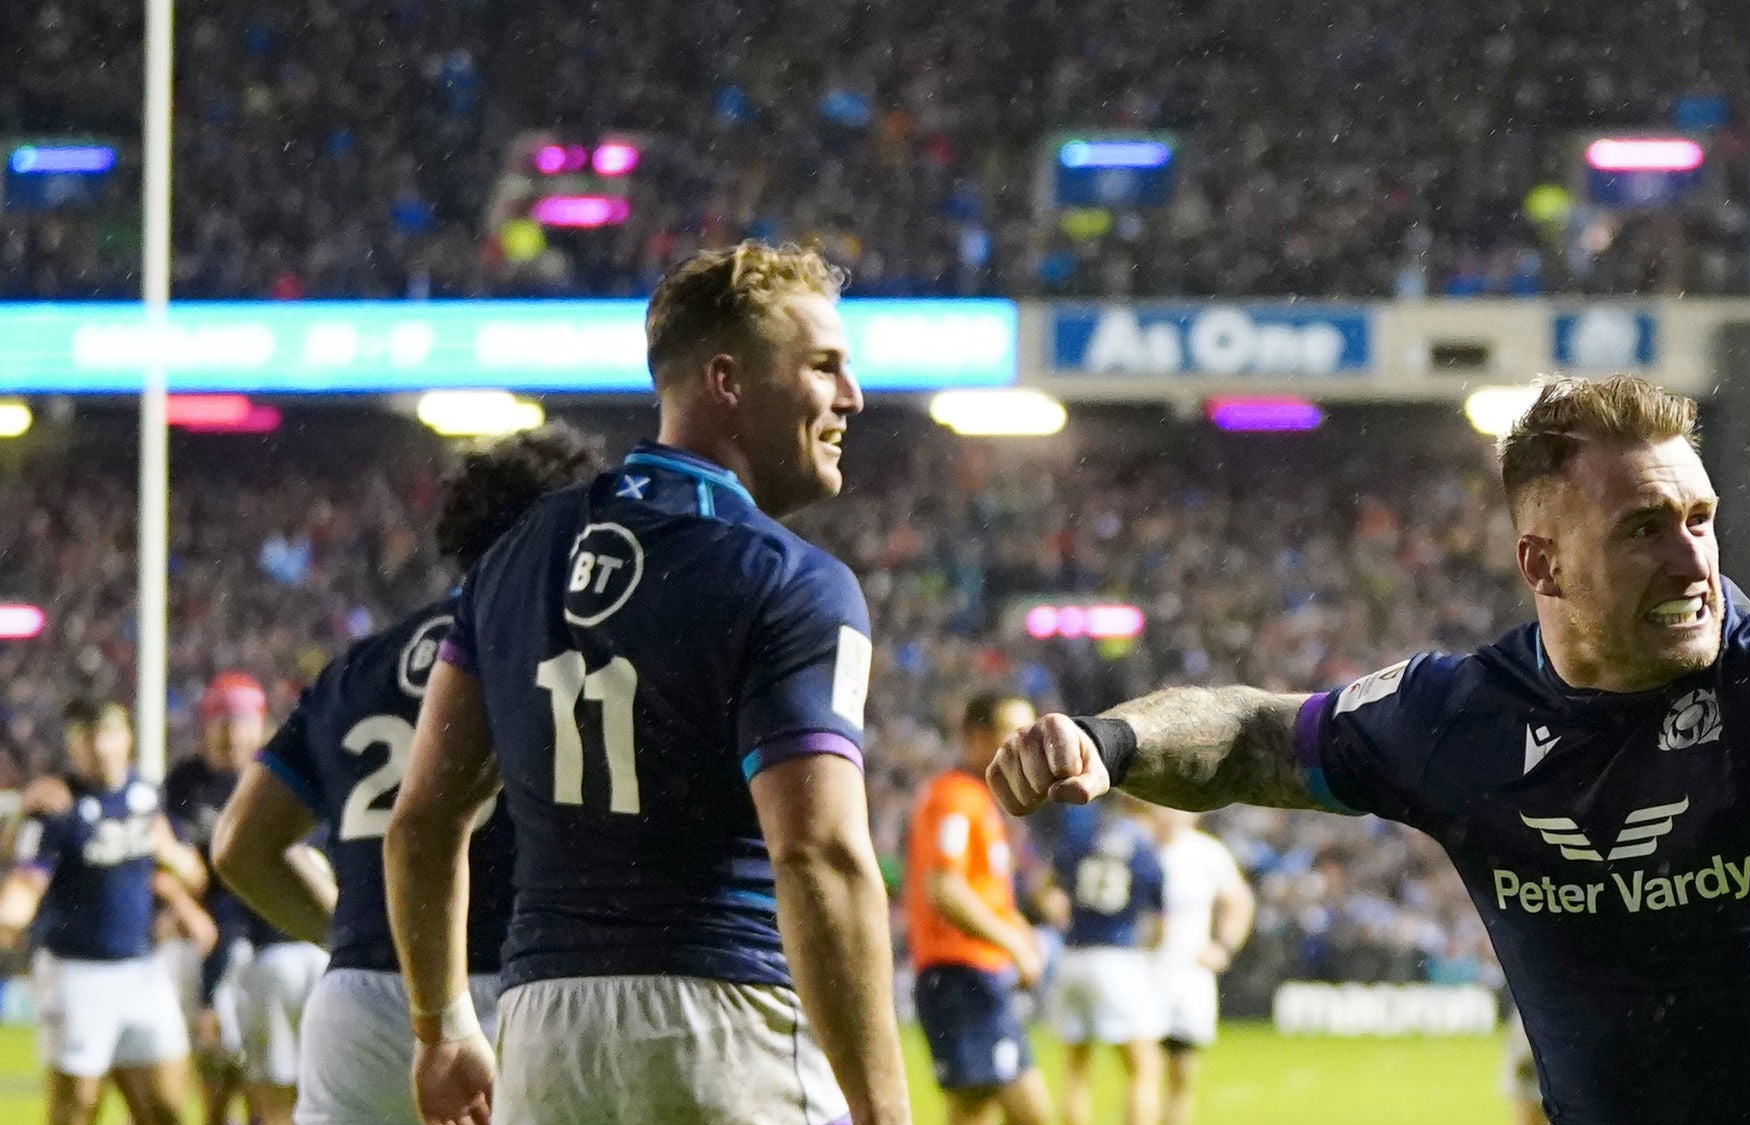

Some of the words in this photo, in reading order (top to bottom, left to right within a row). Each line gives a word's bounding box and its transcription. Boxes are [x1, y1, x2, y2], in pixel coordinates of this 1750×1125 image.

[1086, 308, 1182, 374] As
[1191, 307, 1343, 374] One
[569, 551, 624, 593] BT
[535, 650, 641, 814] 11
[1493, 868, 1604, 914] Peter
